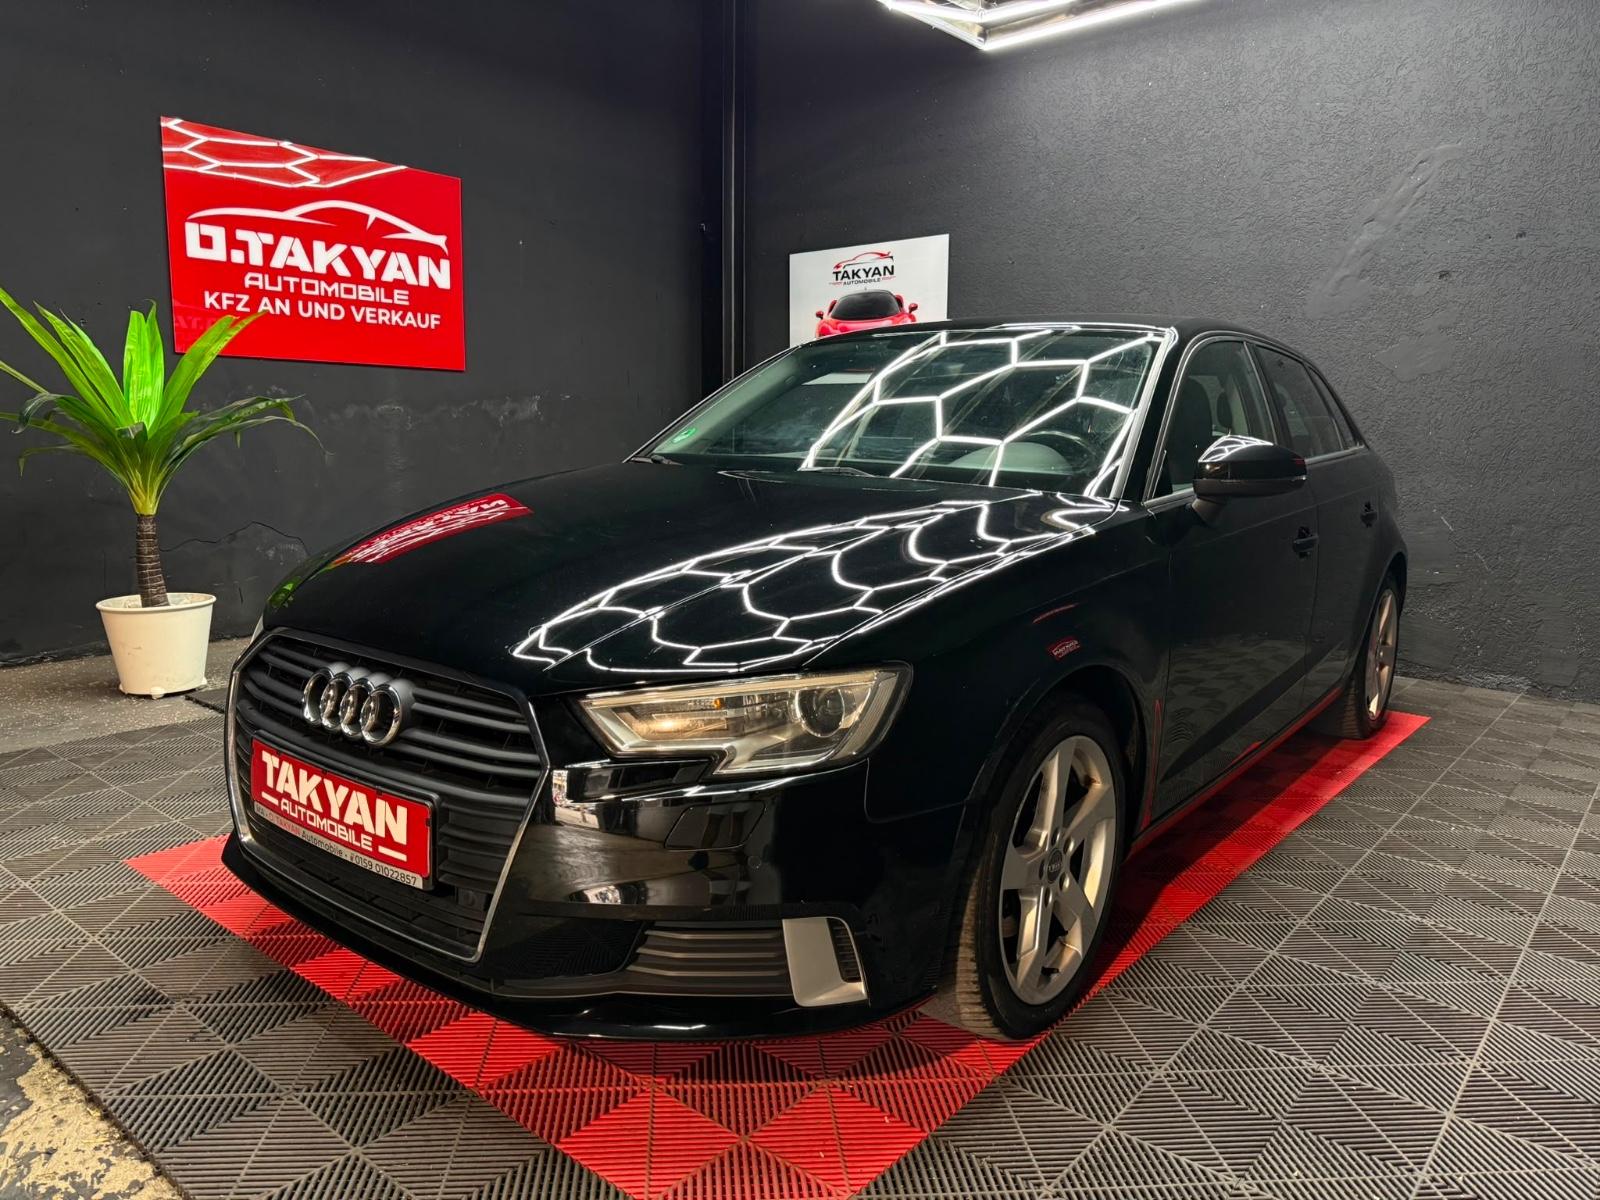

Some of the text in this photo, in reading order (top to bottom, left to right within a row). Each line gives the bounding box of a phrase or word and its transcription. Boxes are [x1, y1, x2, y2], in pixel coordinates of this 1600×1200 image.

[184, 221, 451, 290] O.TAKYAN
[832, 265, 895, 281] TAKYAN
[244, 272, 409, 306] AUTOMOBILE
[842, 277, 881, 286] AUTOMOBILE
[204, 290, 441, 330] KFZ AN UND VERKAUF
[261, 750, 408, 845] TAKYAN
[280, 800, 373, 851] AUTOMOBILE
[301, 829, 343, 857] Automobile
[354, 855, 373, 870] 0159
[375, 863, 417, 886] 01022857
